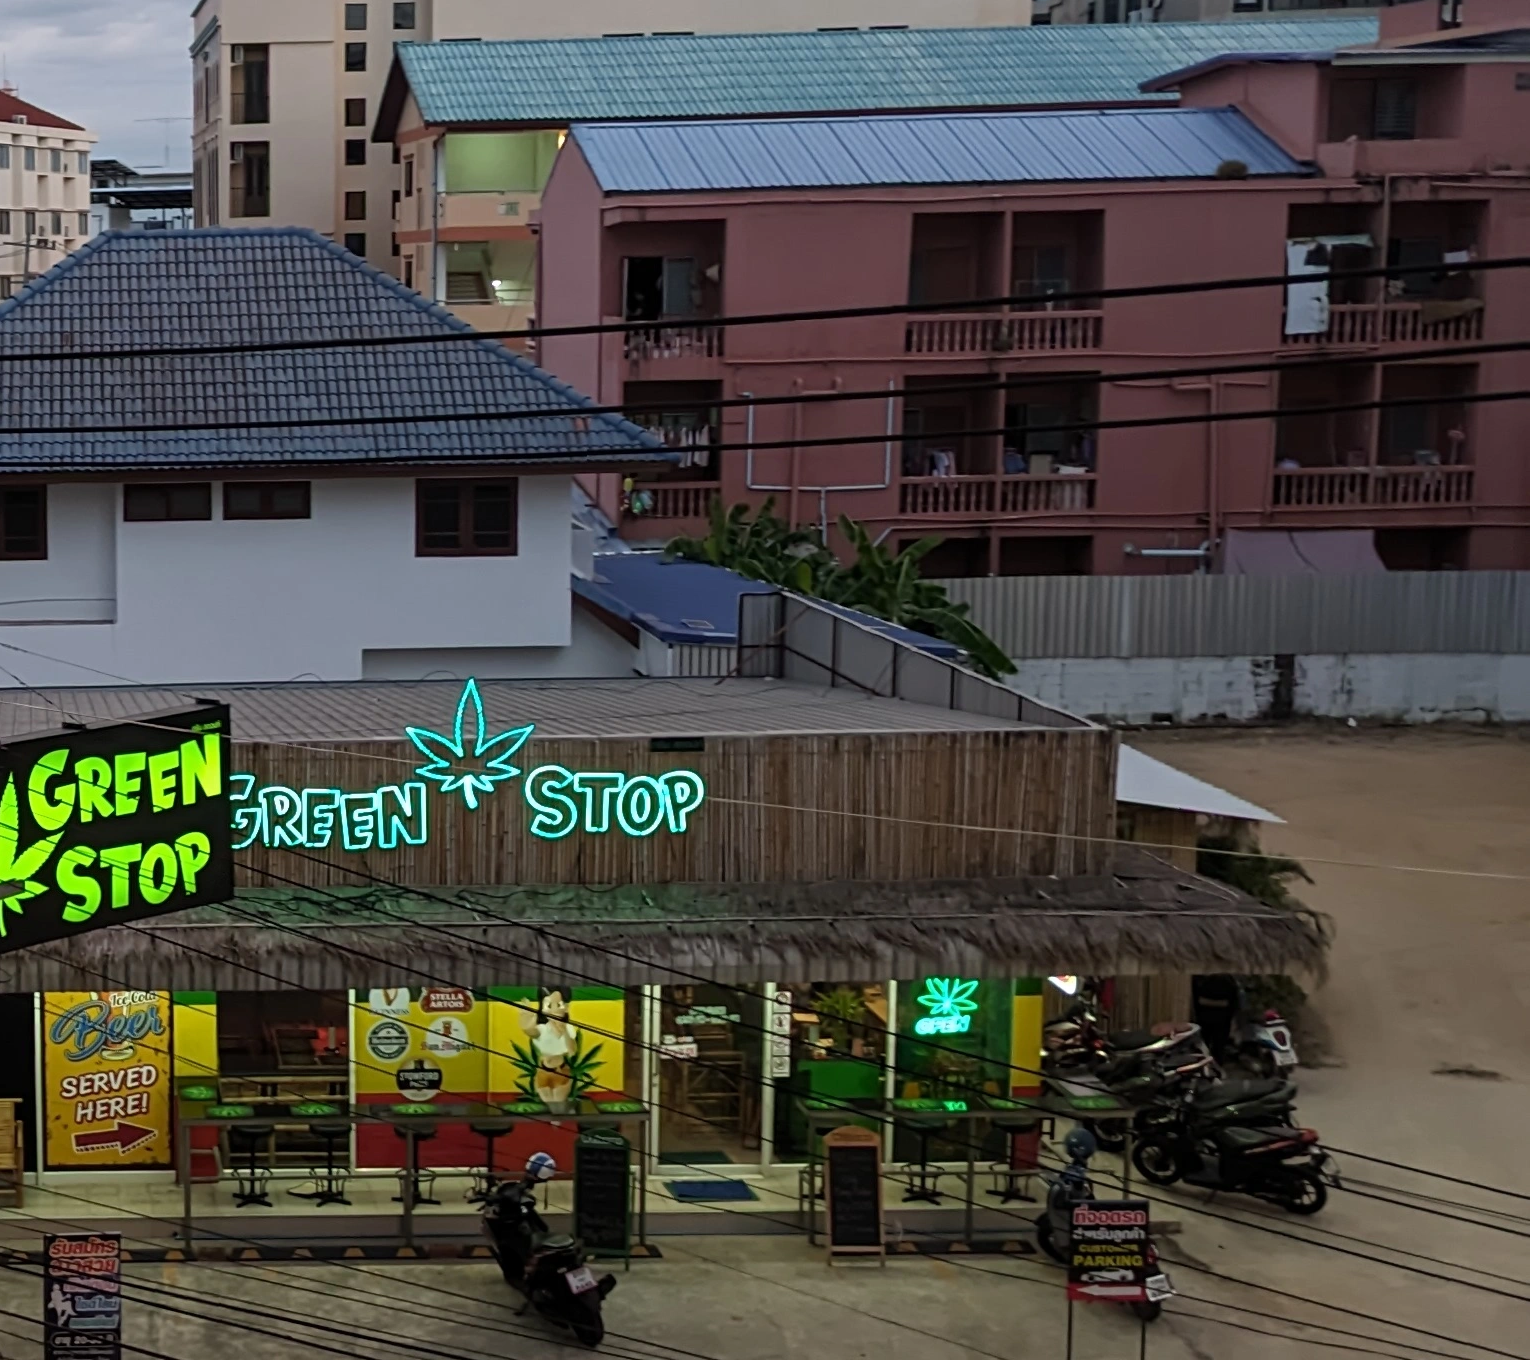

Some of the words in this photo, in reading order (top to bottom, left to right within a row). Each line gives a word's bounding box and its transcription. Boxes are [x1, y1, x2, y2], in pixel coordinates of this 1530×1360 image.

[28, 733, 221, 831] GREEN
[230, 773, 427, 850] GREEN
[524, 764, 705, 839] STOP
[56, 831, 211, 923] STOP
[109, 994, 128, 1007] Ice
[430, 1000, 464, 1008] ARTOIS
[50, 1000, 166, 1062] Beer
[60, 1065, 157, 1098] SERVED
[75, 1093, 149, 1123] HERE!
[1073, 1255, 1144, 1267] PARKING
